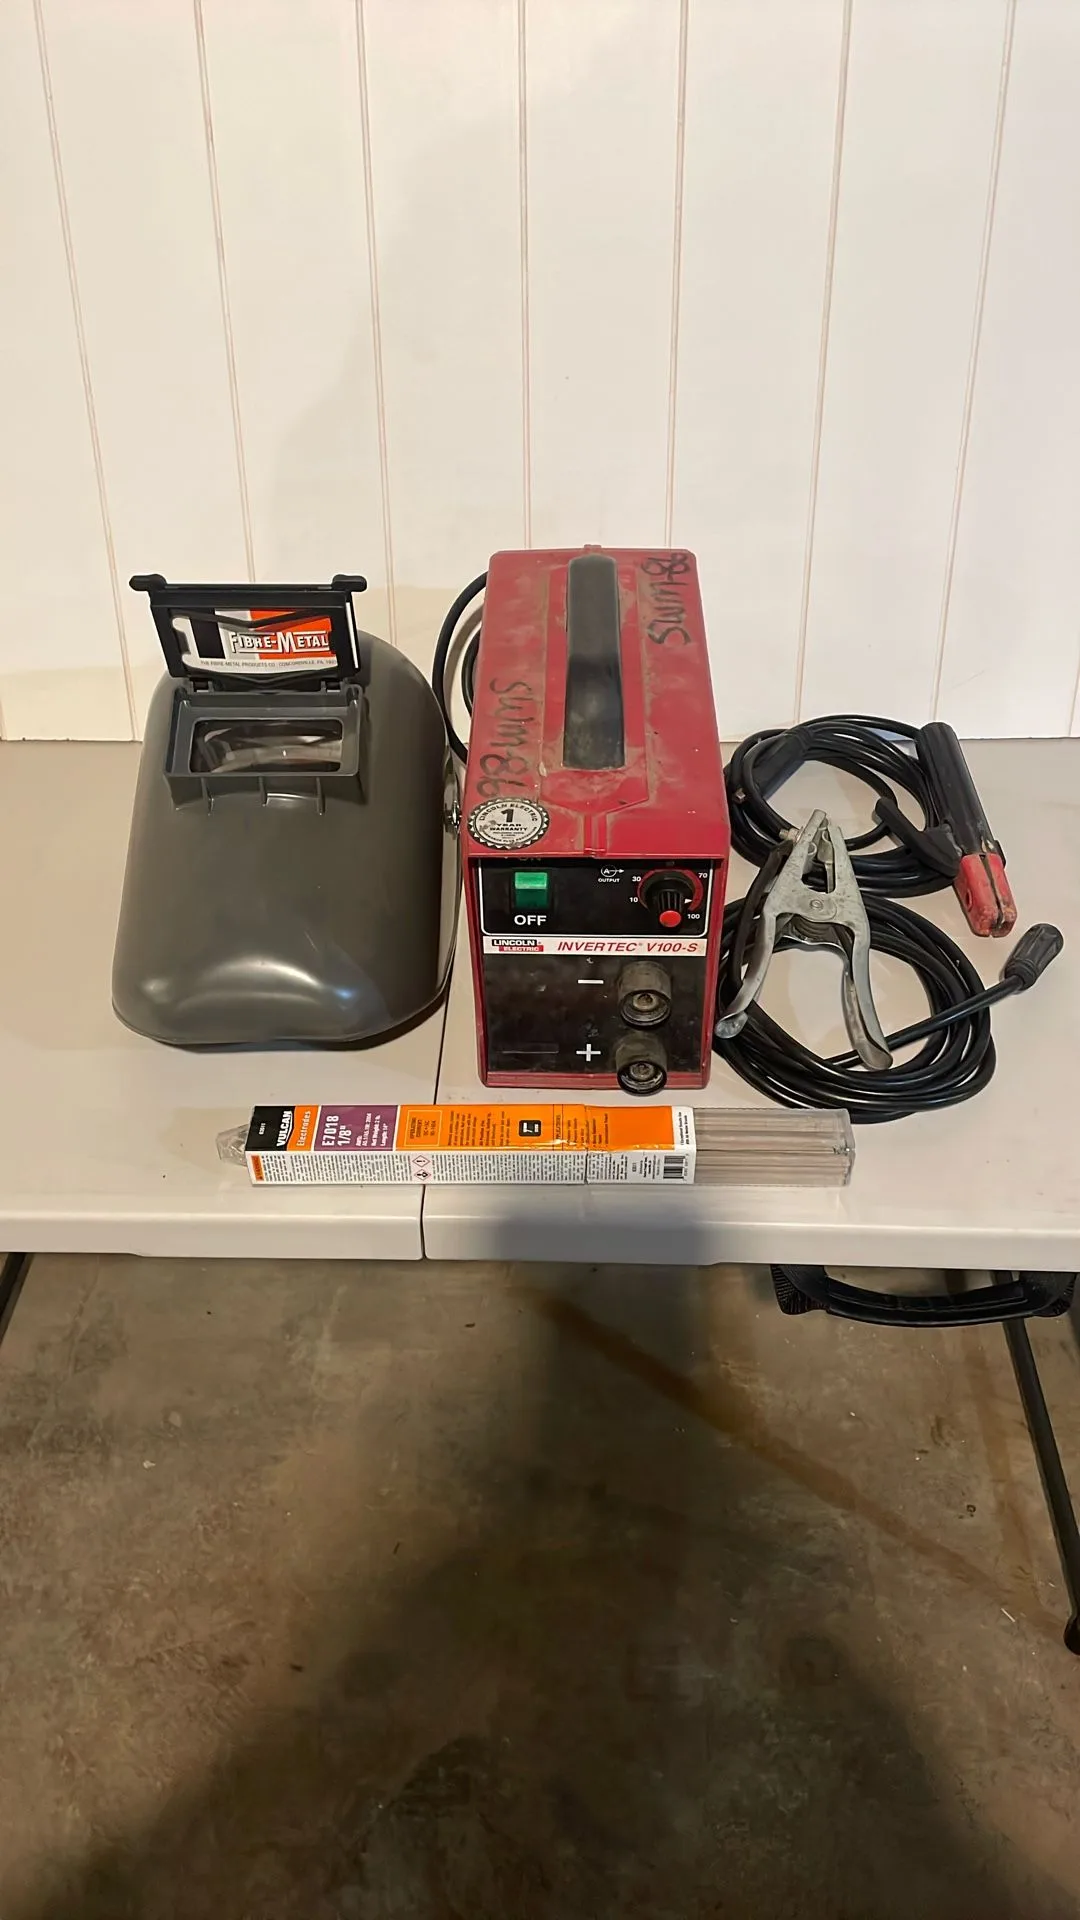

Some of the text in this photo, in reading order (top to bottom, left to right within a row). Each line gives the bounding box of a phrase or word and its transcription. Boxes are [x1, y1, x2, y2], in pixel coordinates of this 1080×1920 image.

[229, 631, 329, 653] FIBRE-METAL
[479, 803, 538, 822] LINCOLN ELECTRIC
[500, 808, 515, 823] 1
[513, 914, 547, 926] OFF
[493, 939, 536, 947] LINCOLN
[646, 942, 699, 953] V100-S
[276, 1110, 291, 1147] VULCAN
[296, 1110, 311, 1147] Electrodes
[321, 1115, 339, 1146] E7018
[337, 1125, 352, 1146] 1/8"
